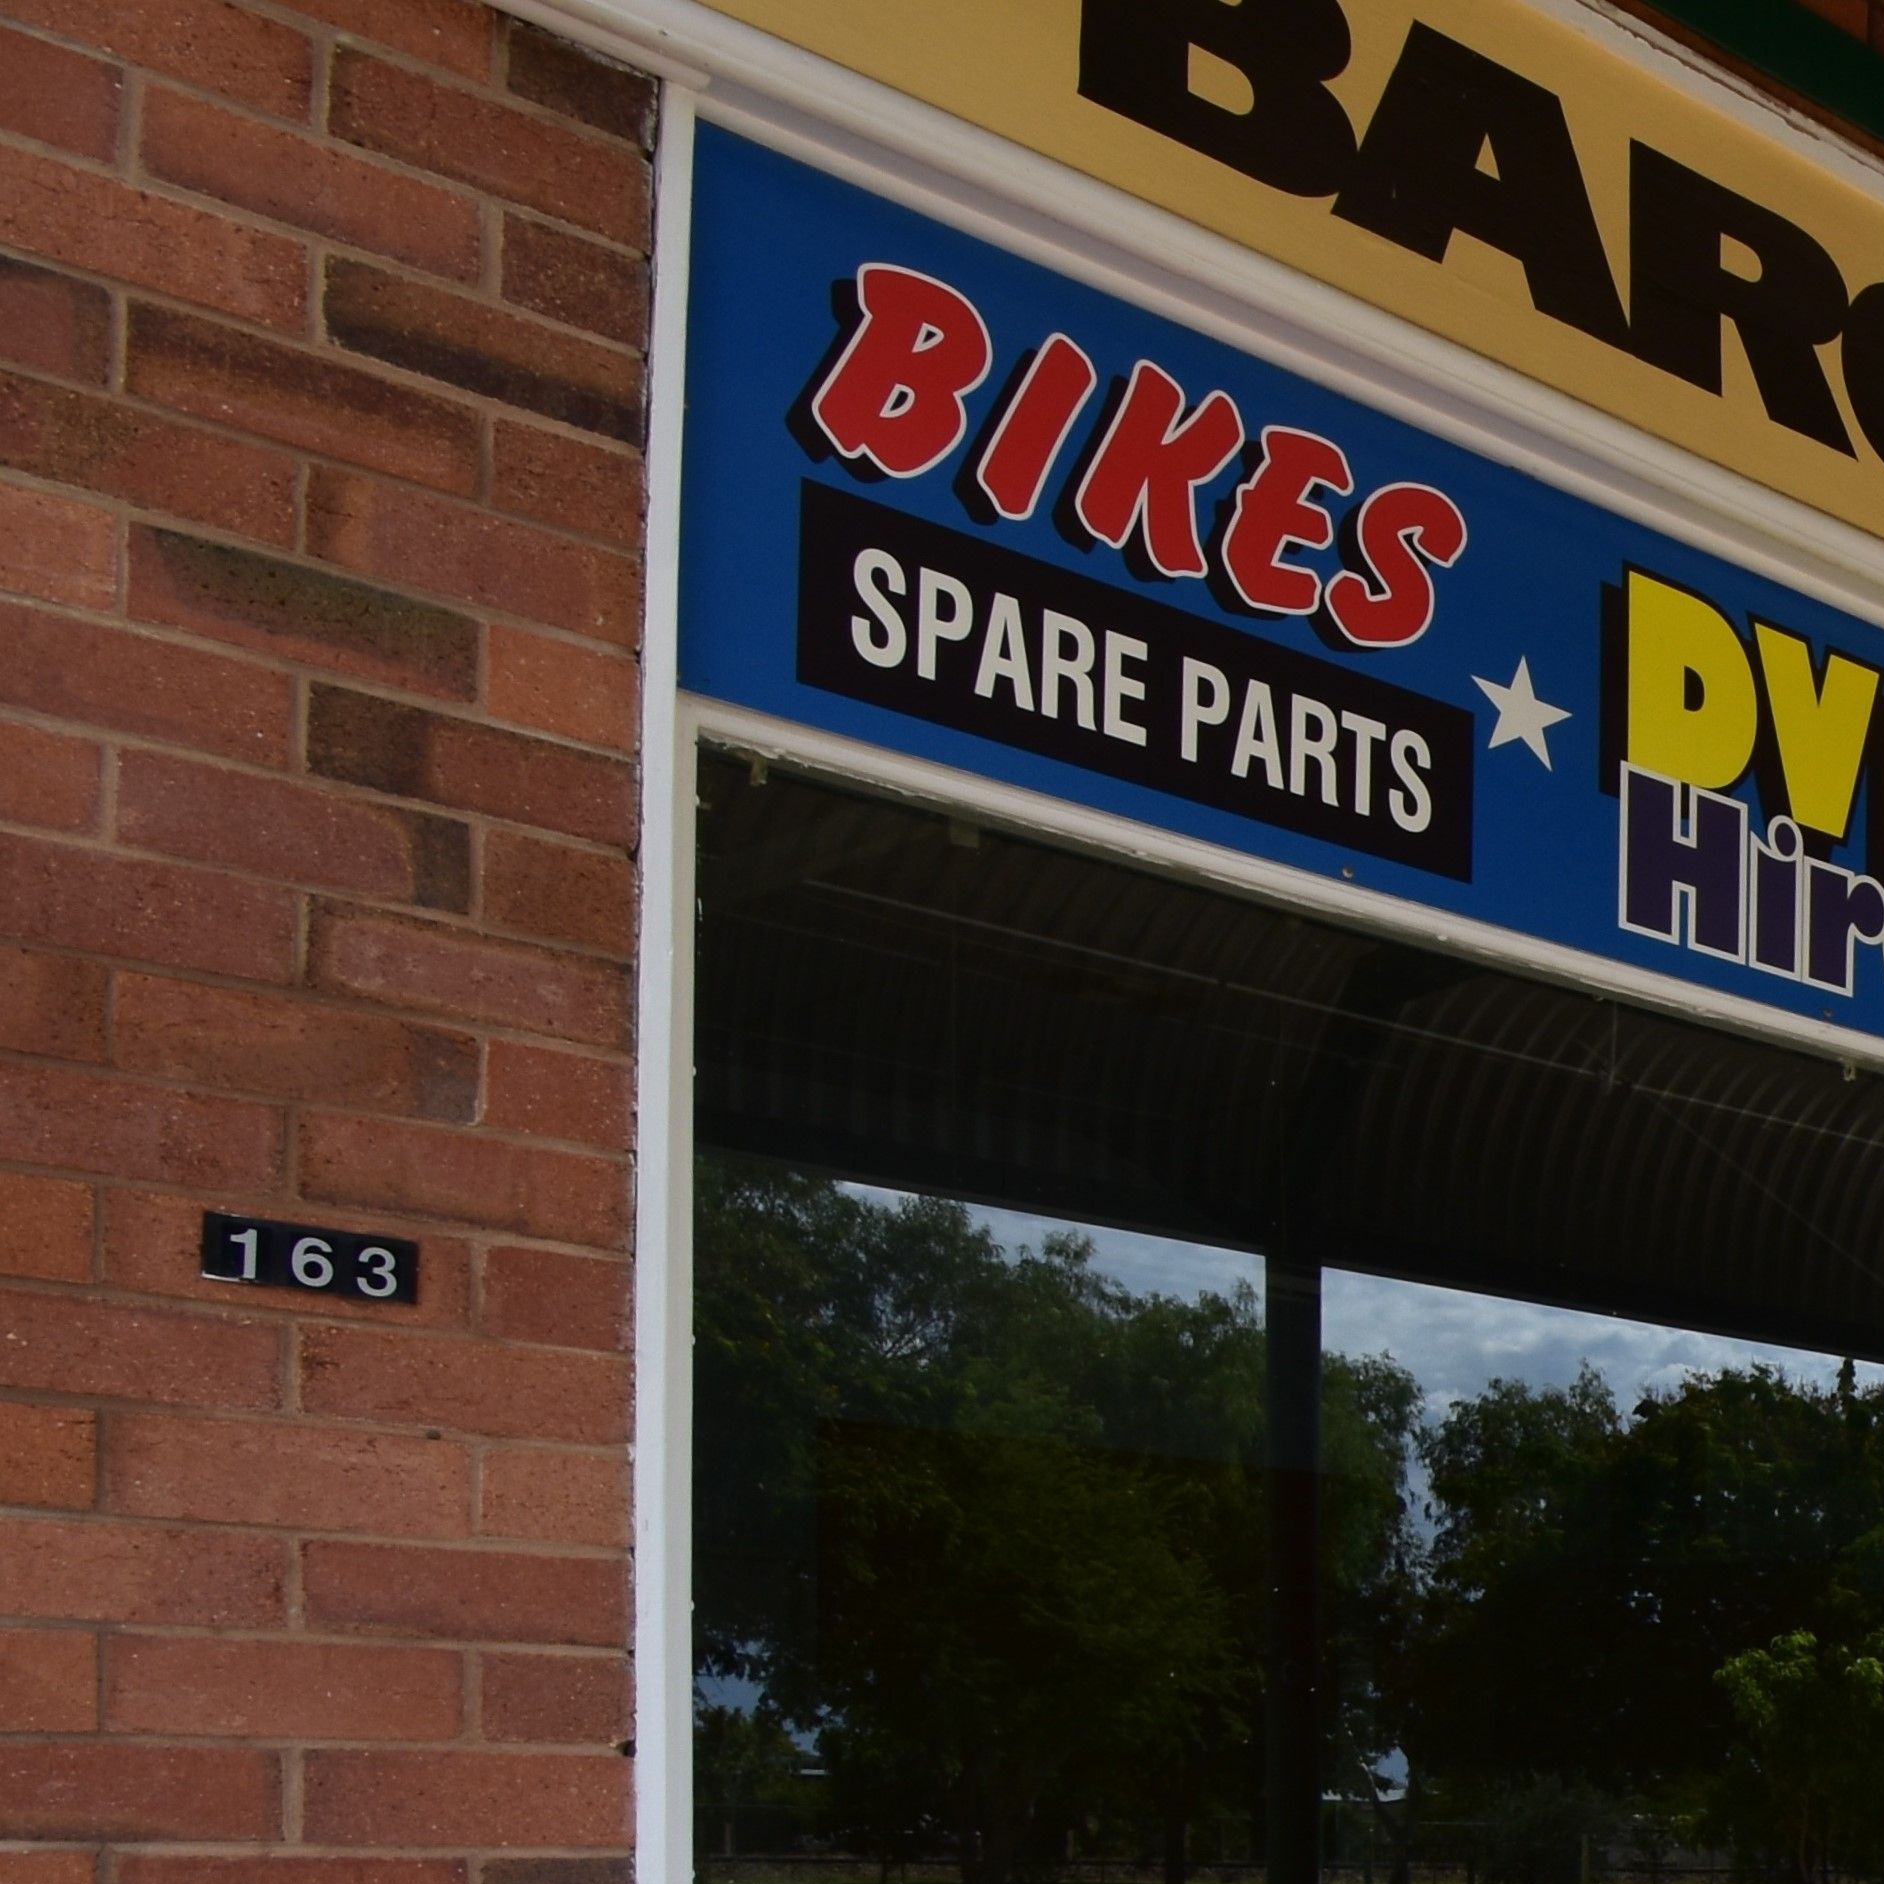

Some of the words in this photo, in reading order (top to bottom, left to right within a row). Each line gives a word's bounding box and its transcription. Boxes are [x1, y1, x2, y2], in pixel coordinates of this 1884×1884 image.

[792, 262, 1467, 648] BIKES
[850, 544, 1150, 748] SPARE
[1178, 656, 1434, 836] PARTS
[229, 1228, 398, 1298] 163
